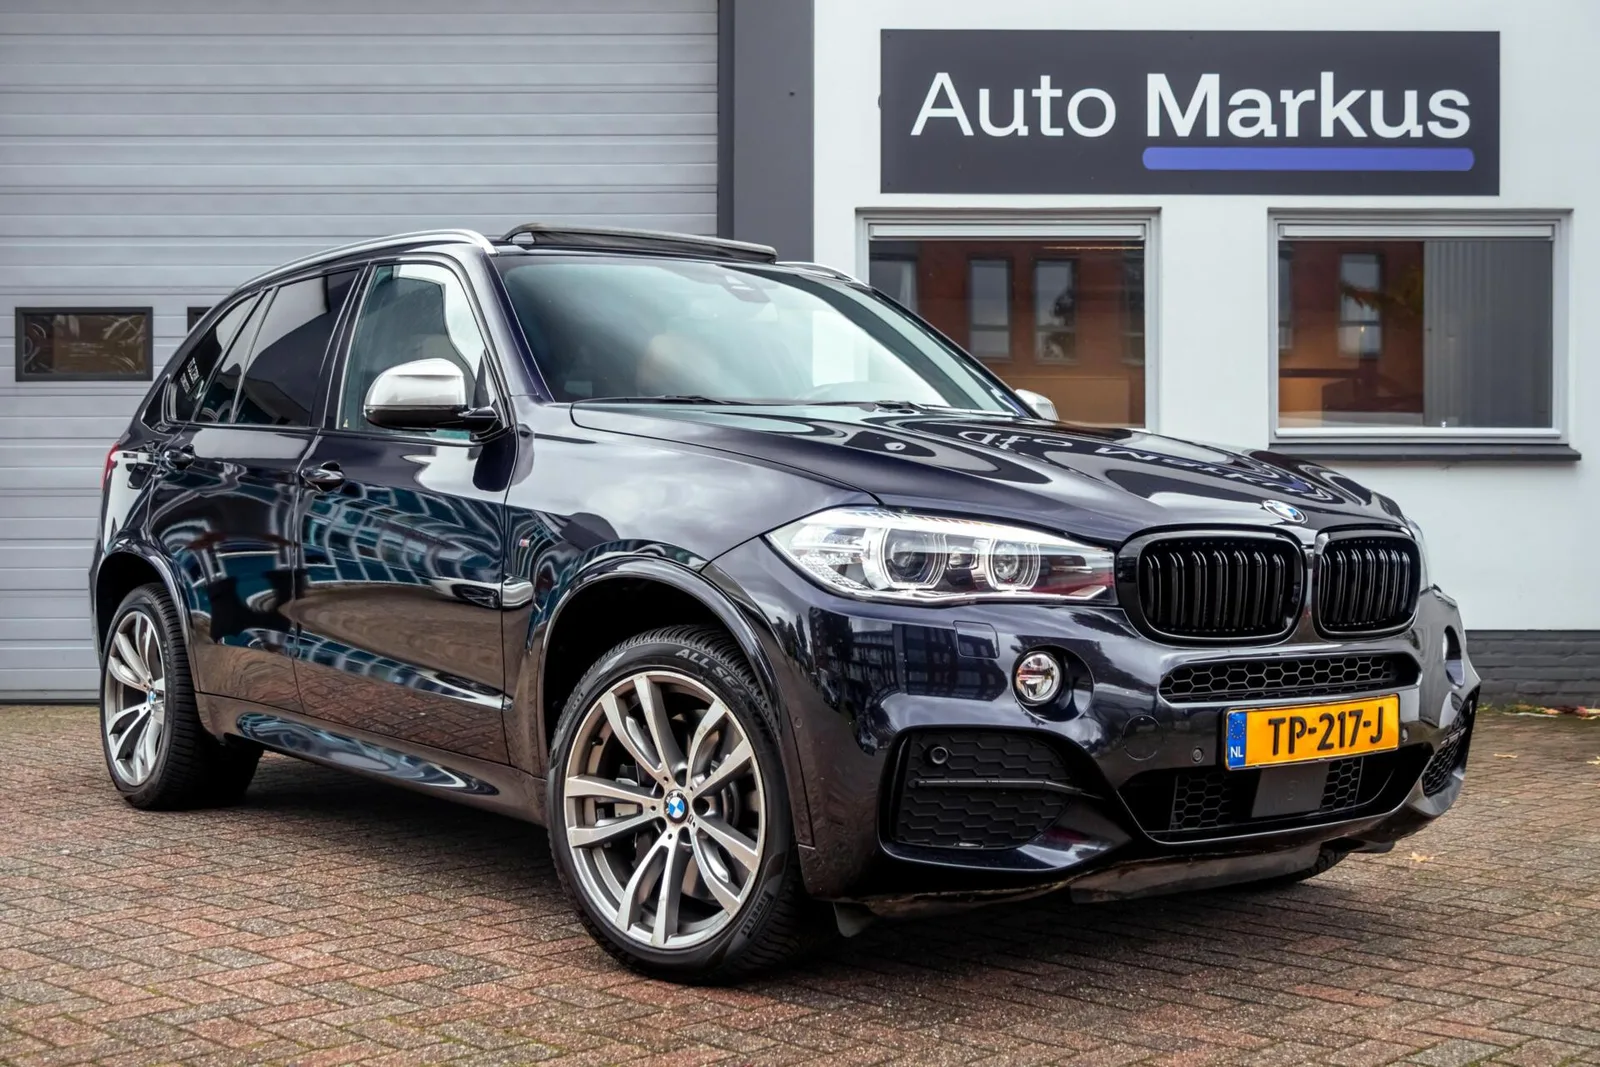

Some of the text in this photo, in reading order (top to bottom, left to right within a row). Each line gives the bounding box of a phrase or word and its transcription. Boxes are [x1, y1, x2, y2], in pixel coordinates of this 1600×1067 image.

[911, 71, 1471, 138] Auto Markus
[675, 648, 709, 669] ALL
[1268, 706, 1384, 756] TP-217-J
[1230, 746, 1243, 758] NL
